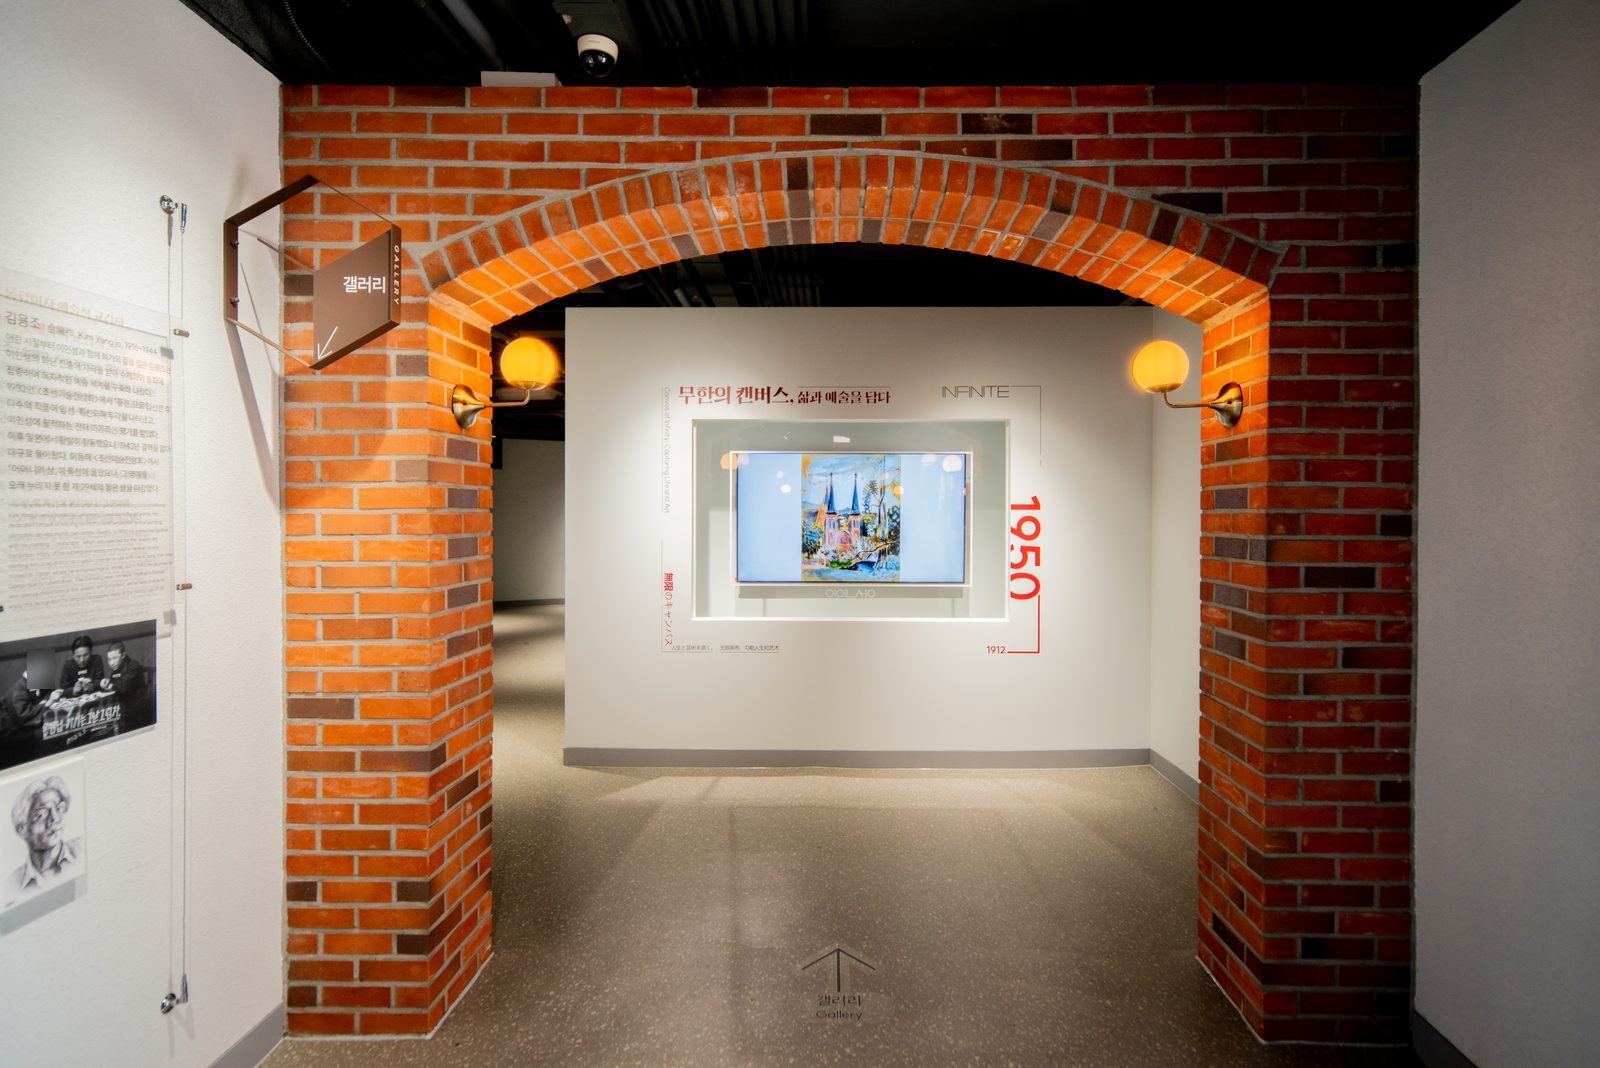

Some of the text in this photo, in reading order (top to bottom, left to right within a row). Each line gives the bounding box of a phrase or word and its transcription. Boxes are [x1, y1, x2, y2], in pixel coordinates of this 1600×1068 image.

[343, 276, 386, 293] 갤러리
[5, 311, 41, 329] 김용조
[663, 387, 671, 411] Canvas
[678, 386, 891, 405] 무한의 캔버스, 삶과 예술을 담다
[942, 385, 1010, 399] INFINITE
[663, 489, 671, 502] and
[1010, 495, 1041, 601] 1950
[664, 572, 674, 646] 無限のキャンバス
[986, 646, 1006, 654] 1912
[816, 995, 861, 1006] 갤러리
[815, 1010, 862, 1020] Gallery
